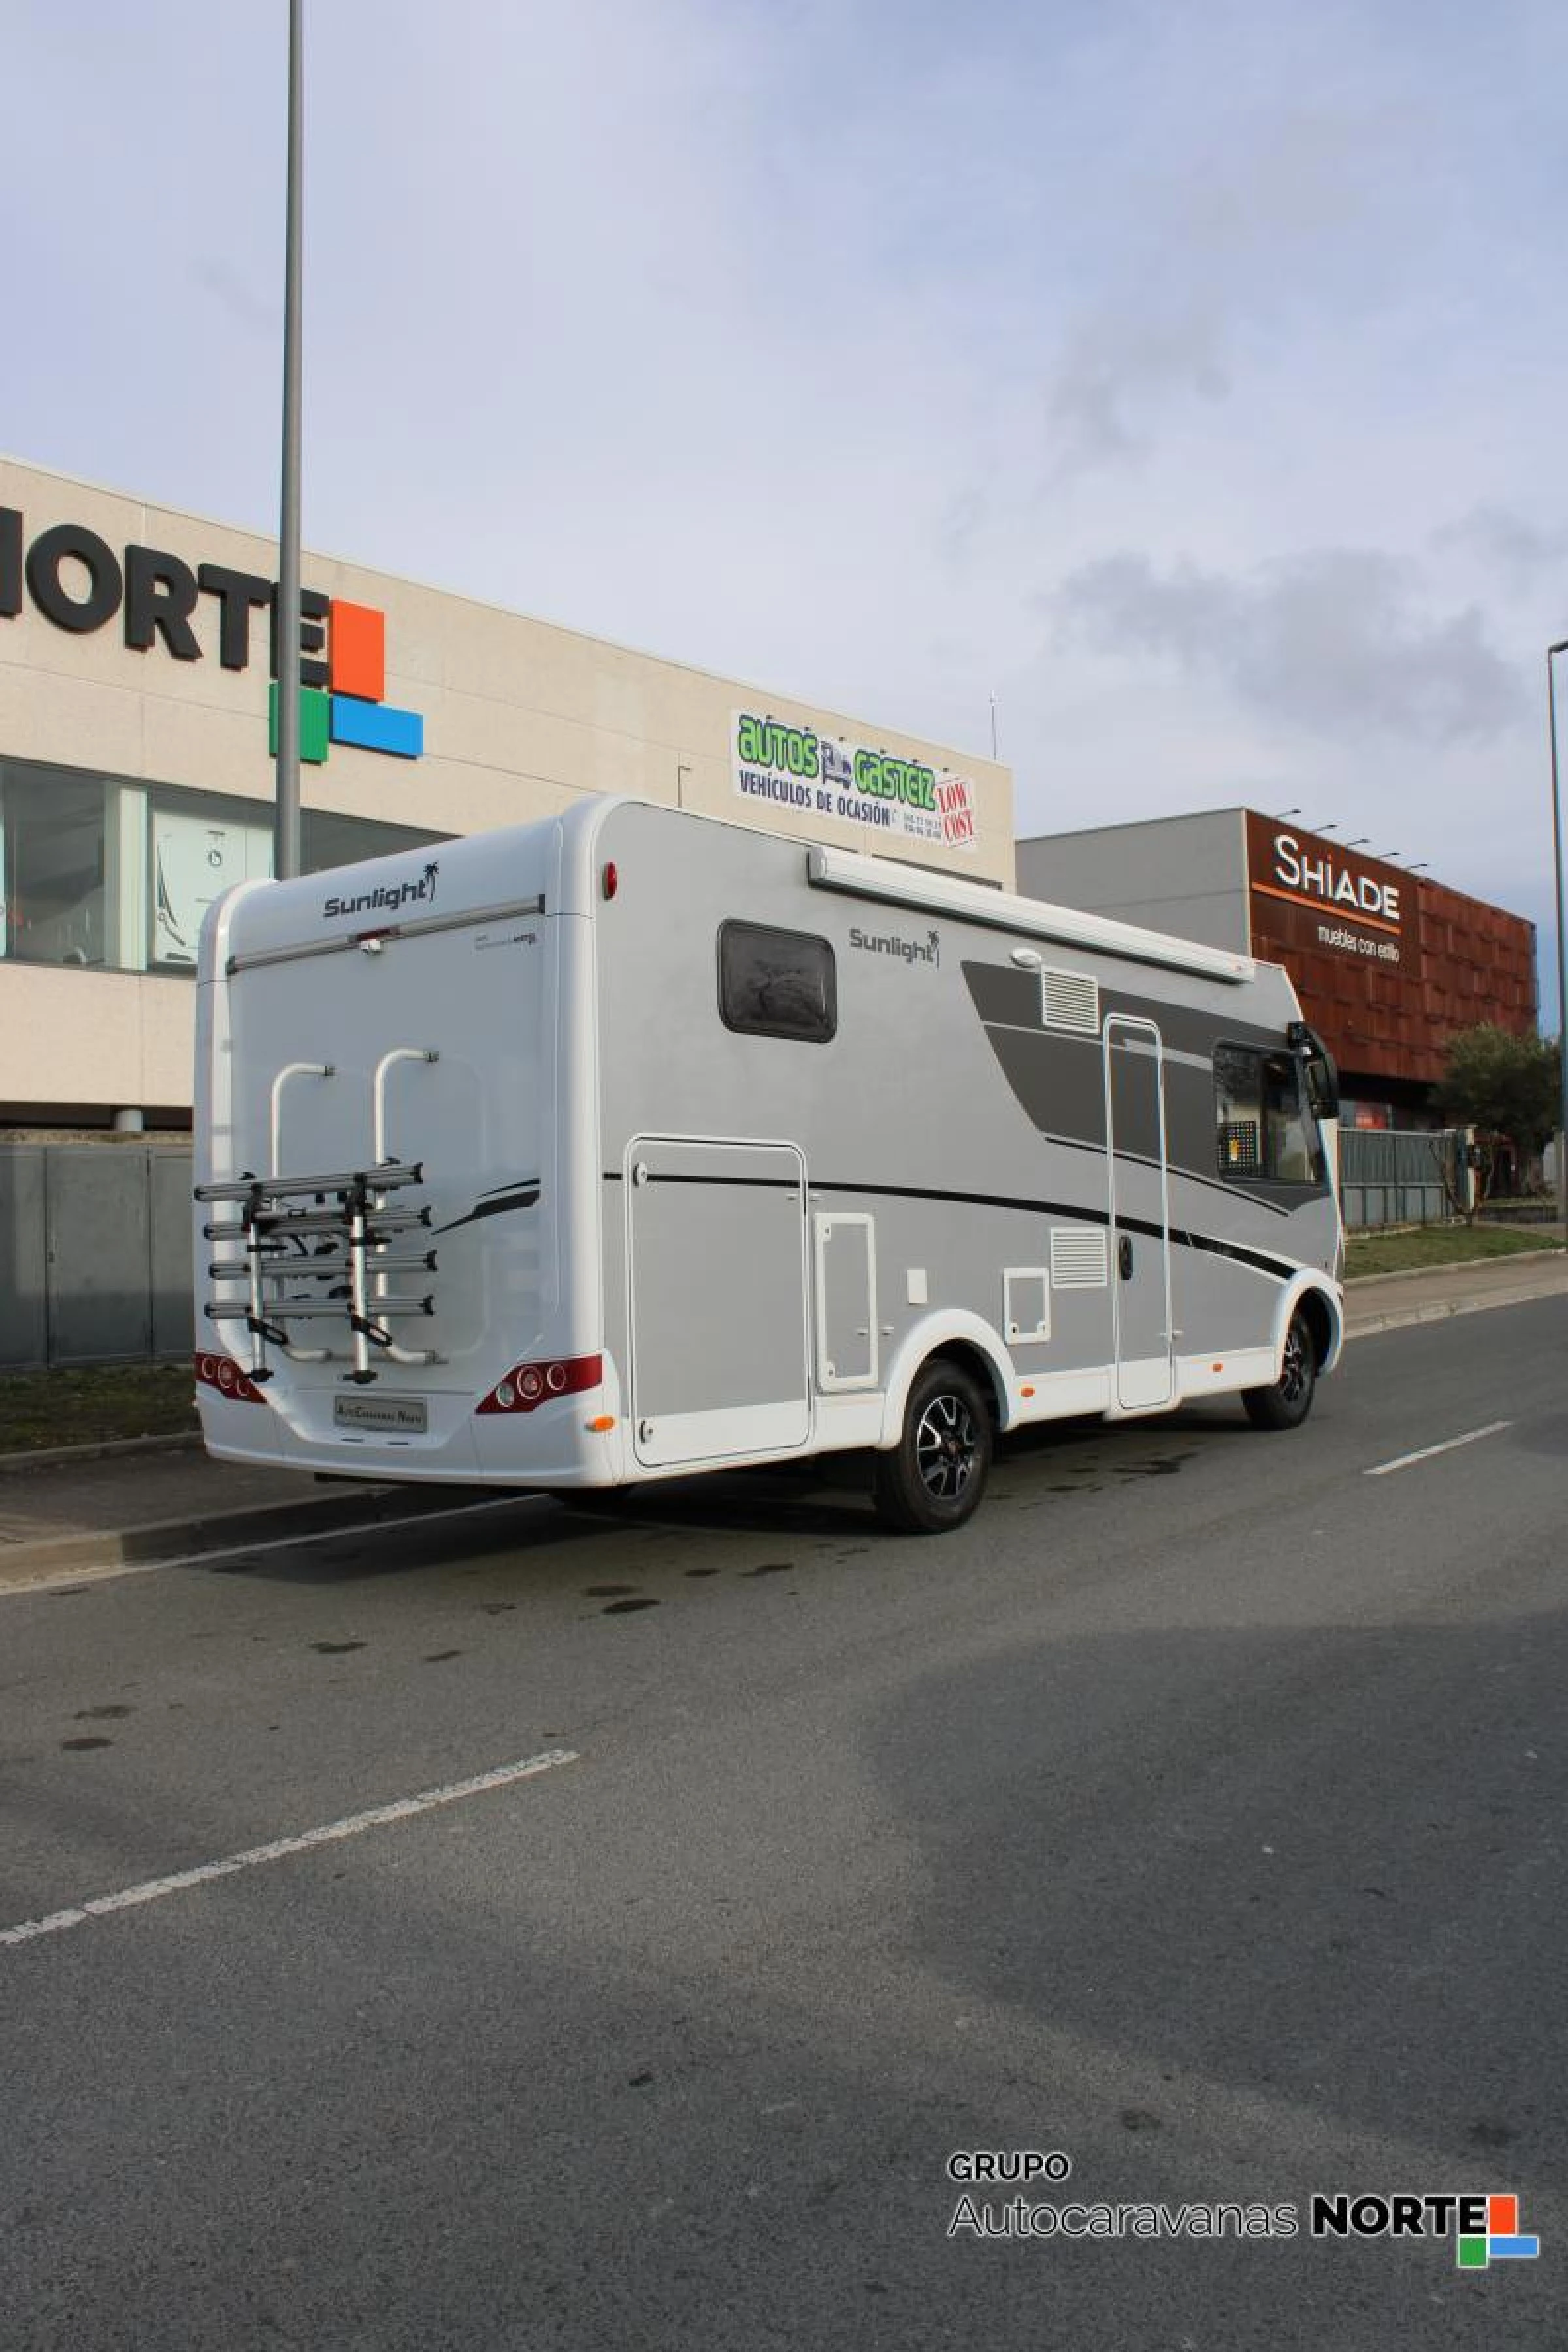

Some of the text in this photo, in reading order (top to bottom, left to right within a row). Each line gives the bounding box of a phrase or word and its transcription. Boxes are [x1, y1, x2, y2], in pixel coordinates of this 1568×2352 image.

[740, 770, 890, 826] VEHÍCULOS DE OCASIÓN
[936, 783, 968, 814] LOW
[943, 809, 973, 841] COST
[323, 879, 426, 918] Sunlight
[849, 928, 934, 964] Sunlight
[1318, 926, 1400, 963] muebles con estilo
